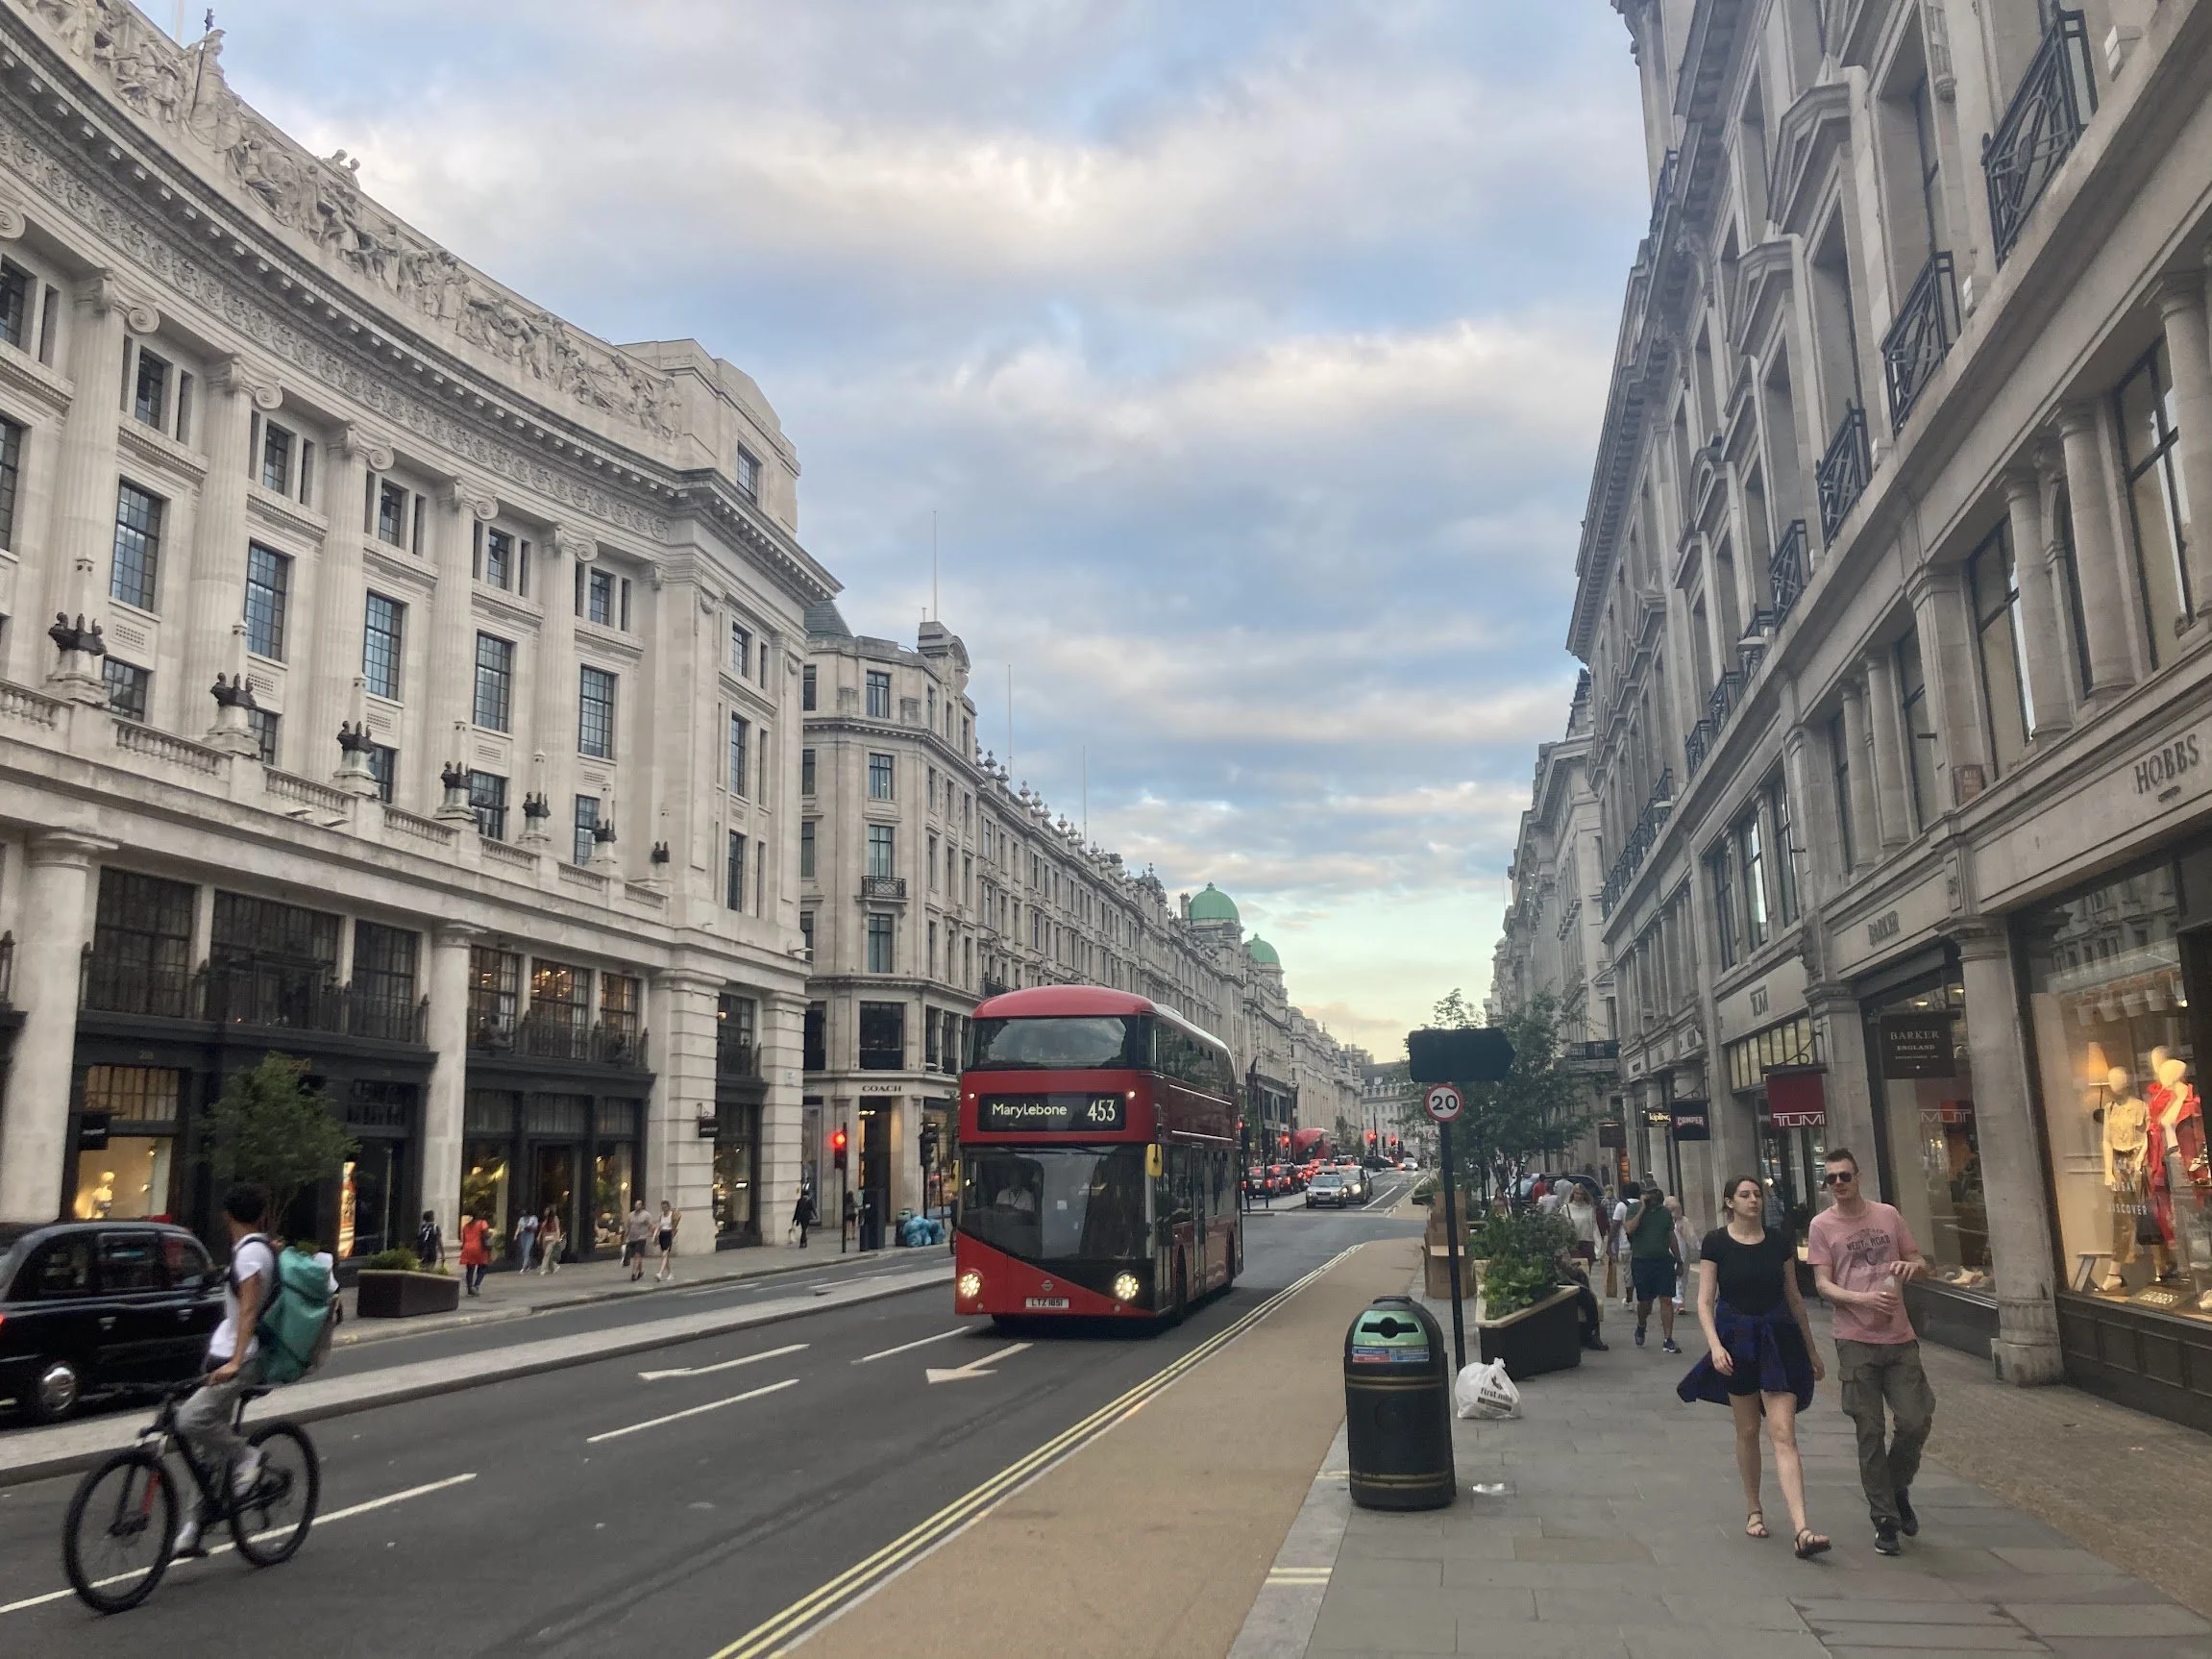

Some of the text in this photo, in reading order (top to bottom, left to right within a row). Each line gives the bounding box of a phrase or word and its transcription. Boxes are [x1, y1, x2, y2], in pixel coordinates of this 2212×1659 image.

[2134, 733, 2200, 795] HOBBS
[1890, 1030, 1940, 1040] BARKER
[1431, 1095, 1458, 1110] 20
[992, 1099, 1116, 1122] Marylebone 453
[1649, 1112, 1671, 1122] kipling
[1677, 1116, 1704, 1127] CAMPER
[1773, 1111, 1825, 1127] TUMI
